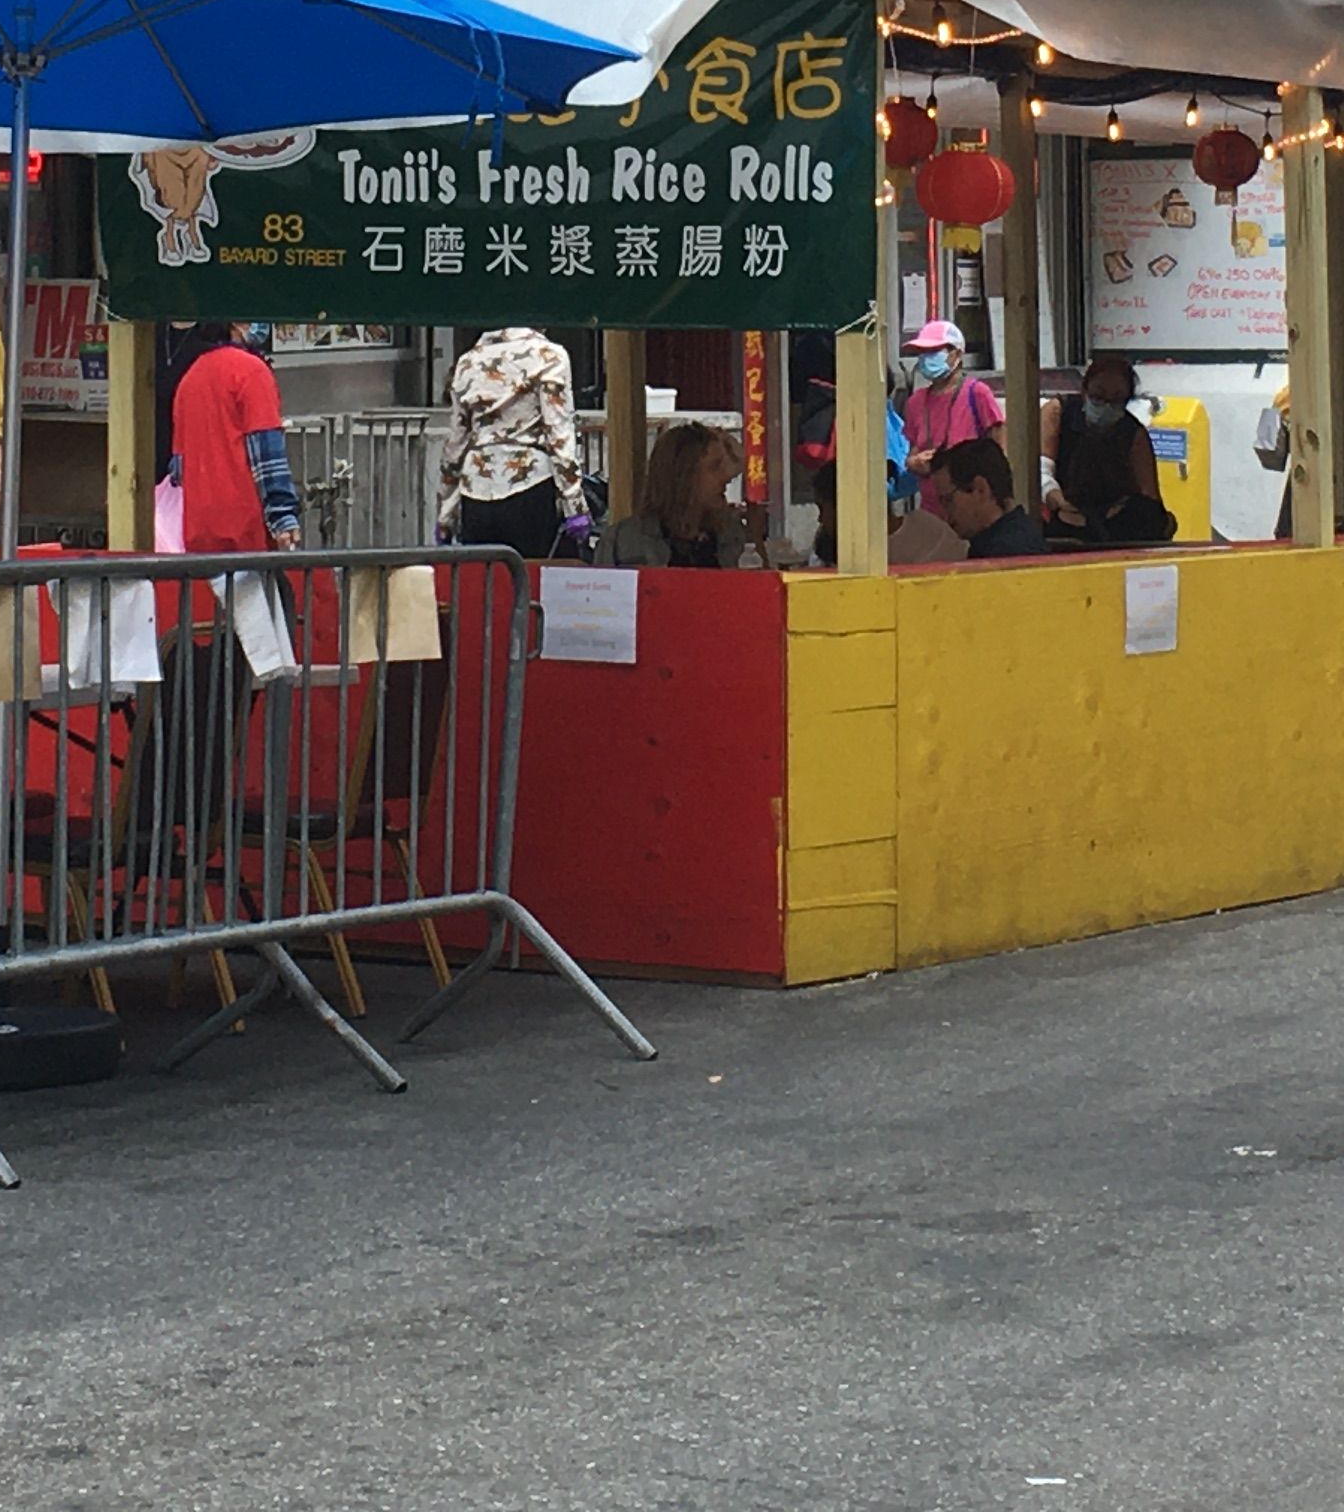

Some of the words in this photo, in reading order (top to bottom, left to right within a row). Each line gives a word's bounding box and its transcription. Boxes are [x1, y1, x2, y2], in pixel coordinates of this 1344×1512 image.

[337, 147, 457, 205] Tonii's
[478, 145, 590, 205] Fresh
[612, 144, 706, 203] Rice
[729, 144, 833, 203] Rolls
[263, 213, 305, 244] 83
[219, 247, 278, 266] BAYARD
[285, 248, 347, 267] STREET
